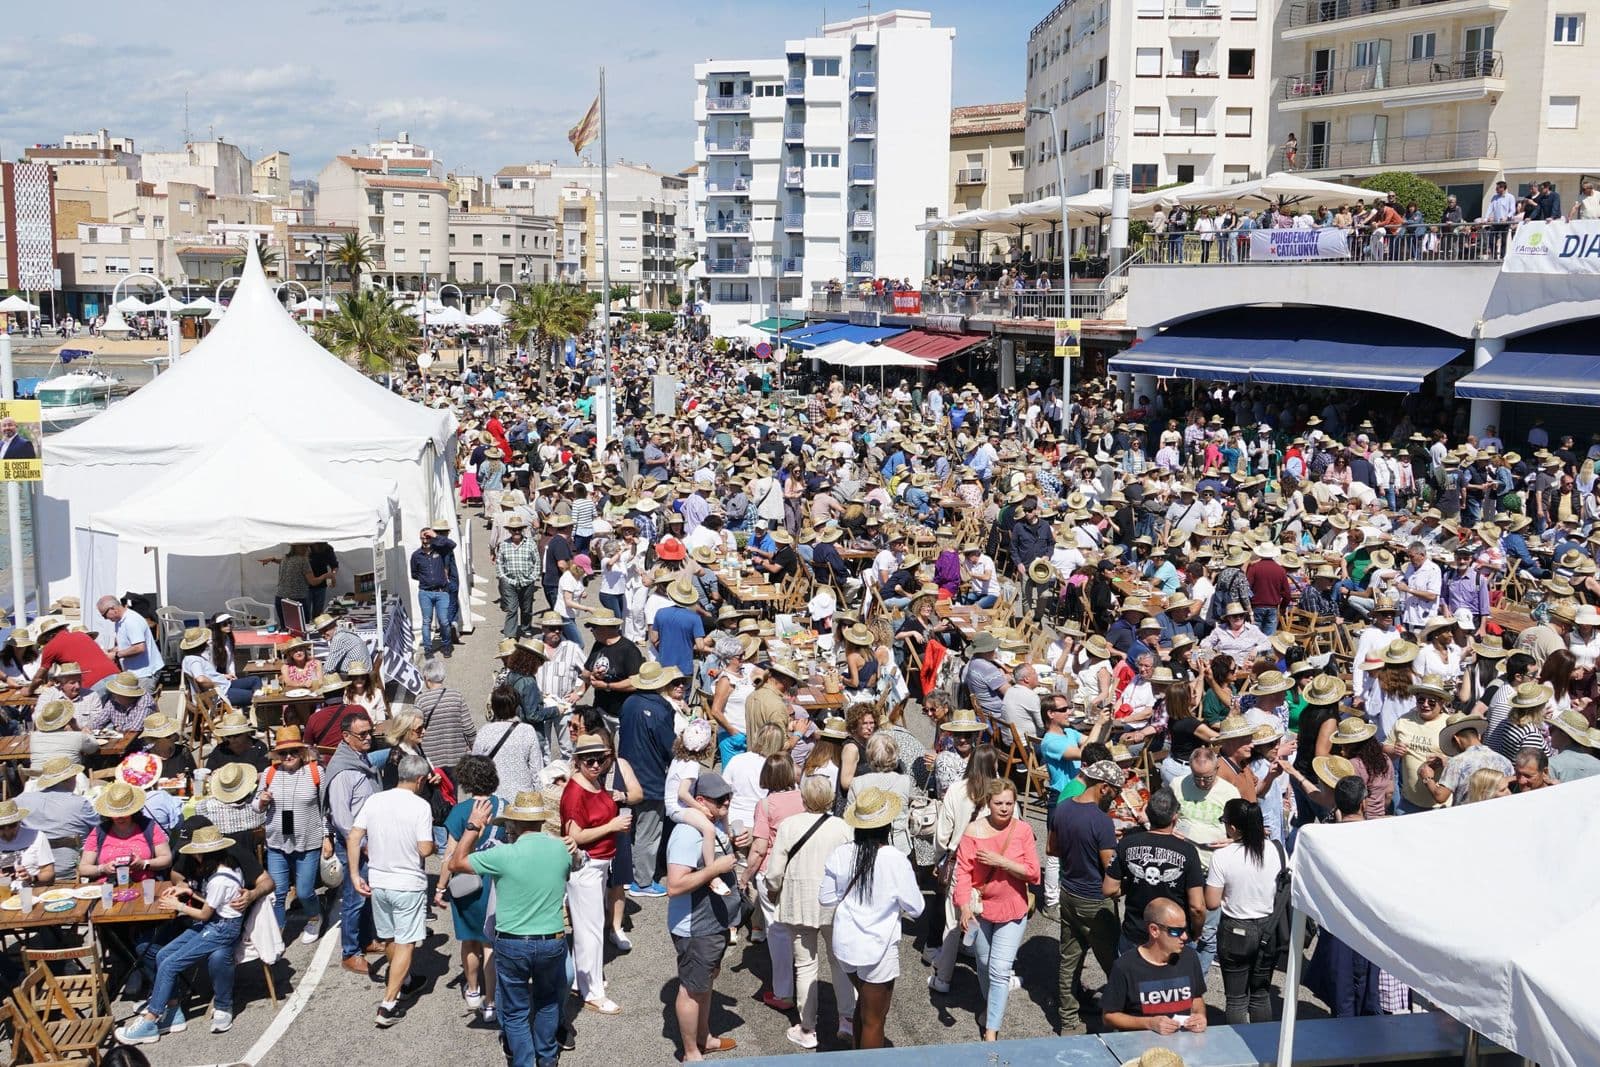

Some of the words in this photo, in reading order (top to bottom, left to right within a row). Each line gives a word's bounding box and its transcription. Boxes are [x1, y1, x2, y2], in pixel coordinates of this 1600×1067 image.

[1270, 231, 1322, 244] PUIGDEMONT
[1277, 244, 1320, 257] CATALUNYA
[4, 461, 10, 470] AL
[12, 461, 30, 470] COSTAT
[4, 470, 11, 479] DE
[13, 470, 41, 479] CATALUNYA
